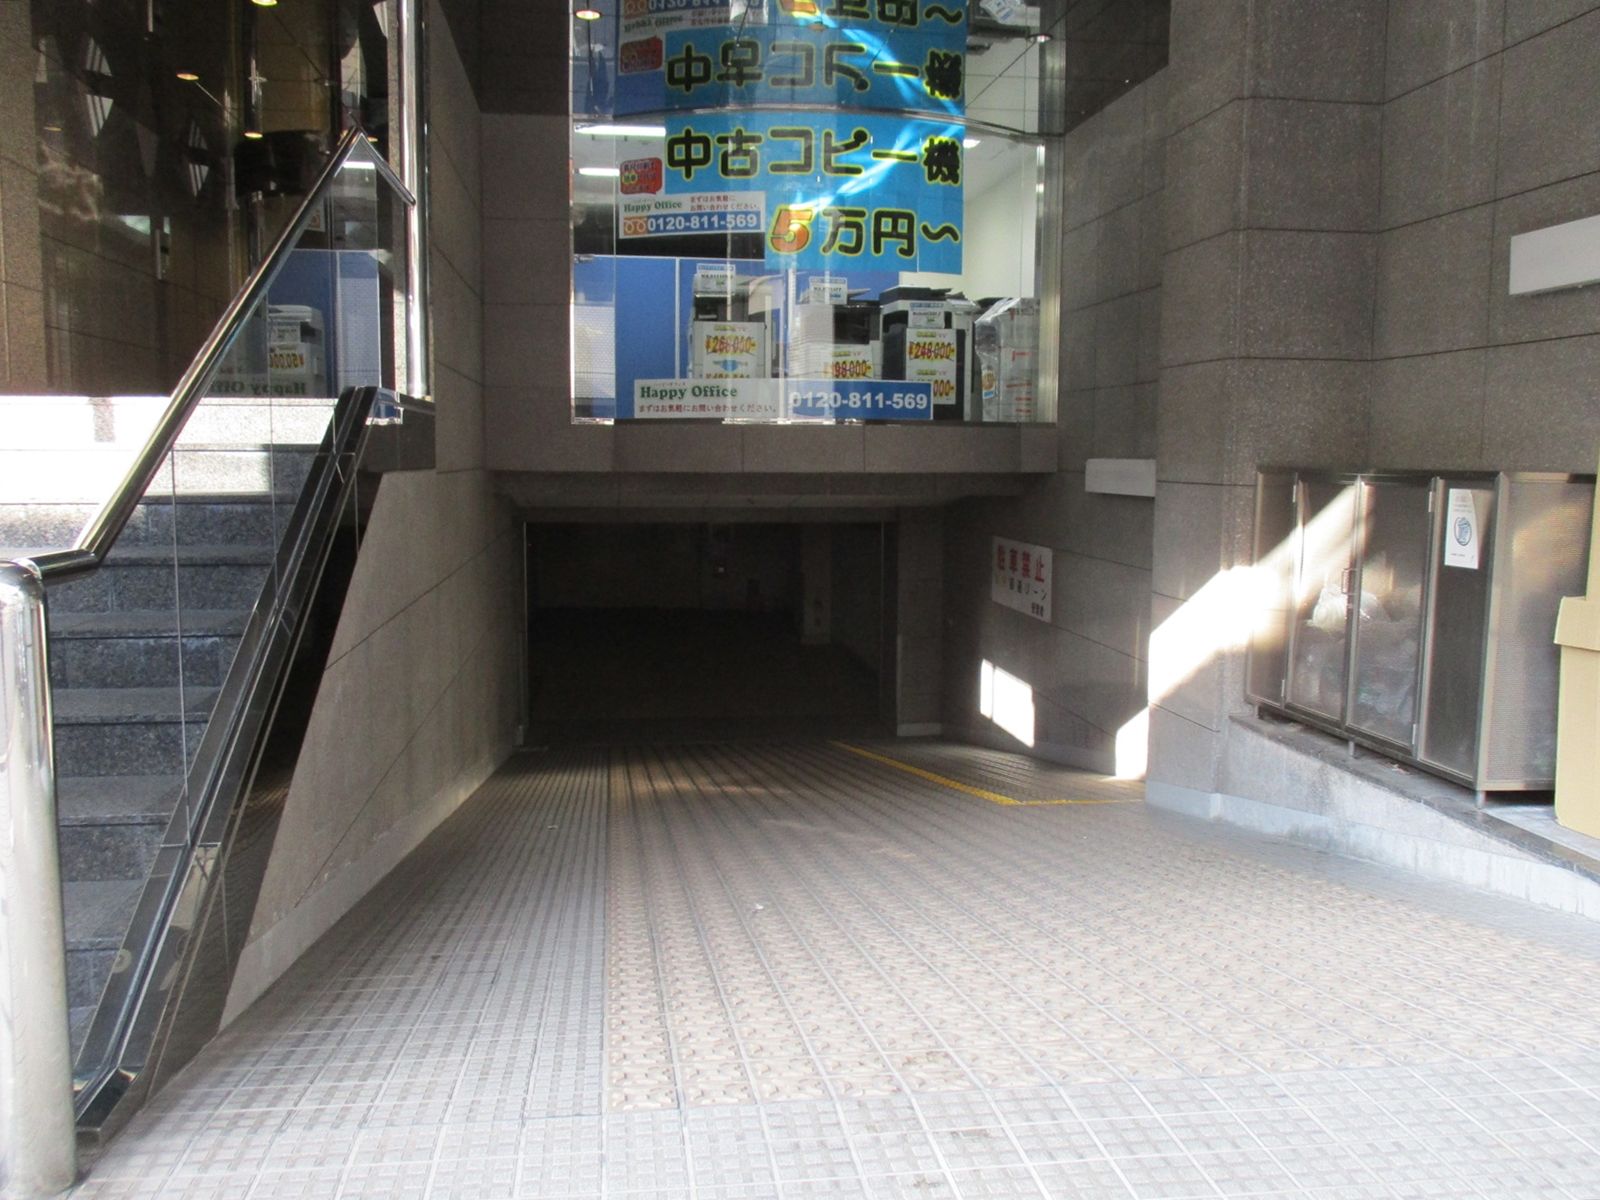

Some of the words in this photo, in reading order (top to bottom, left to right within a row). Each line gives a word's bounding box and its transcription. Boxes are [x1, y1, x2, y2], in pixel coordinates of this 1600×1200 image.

[667, 127, 960, 184] 中古コピー機
[624, 202, 651, 213] Happy
[654, 201, 682, 211] Office
[647, 213, 758, 232] 0120-811-569
[640, 386, 687, 399] Happy
[691, 385, 738, 398] Office
[789, 391, 928, 409] 0120-811-569
